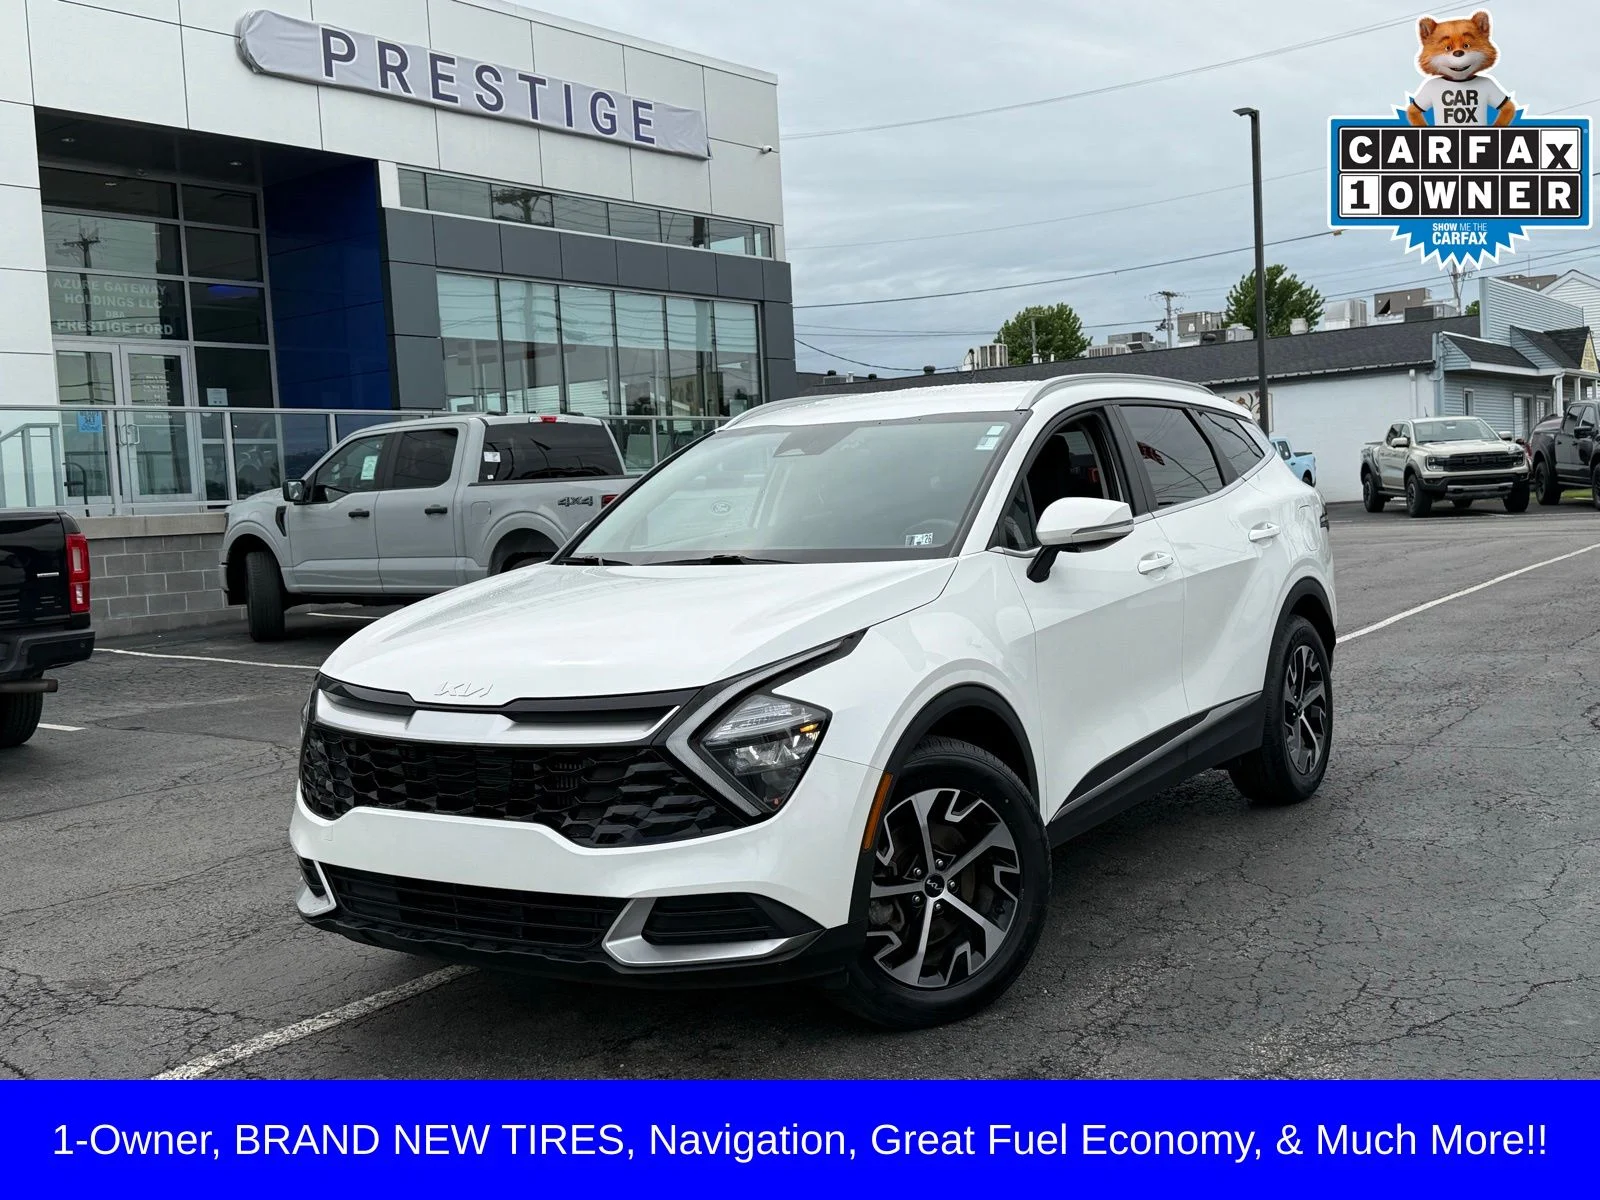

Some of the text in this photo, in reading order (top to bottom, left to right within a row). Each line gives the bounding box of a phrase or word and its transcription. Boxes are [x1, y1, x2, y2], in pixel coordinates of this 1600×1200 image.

[320, 26, 656, 145] PRESTIGE
[54, 279, 166, 296] AZURE GATEWAY
[64, 294, 162, 309] HOLDINGS LLC
[105, 310, 125, 318] DBA
[56, 319, 174, 335] PRESTIGE FORD
